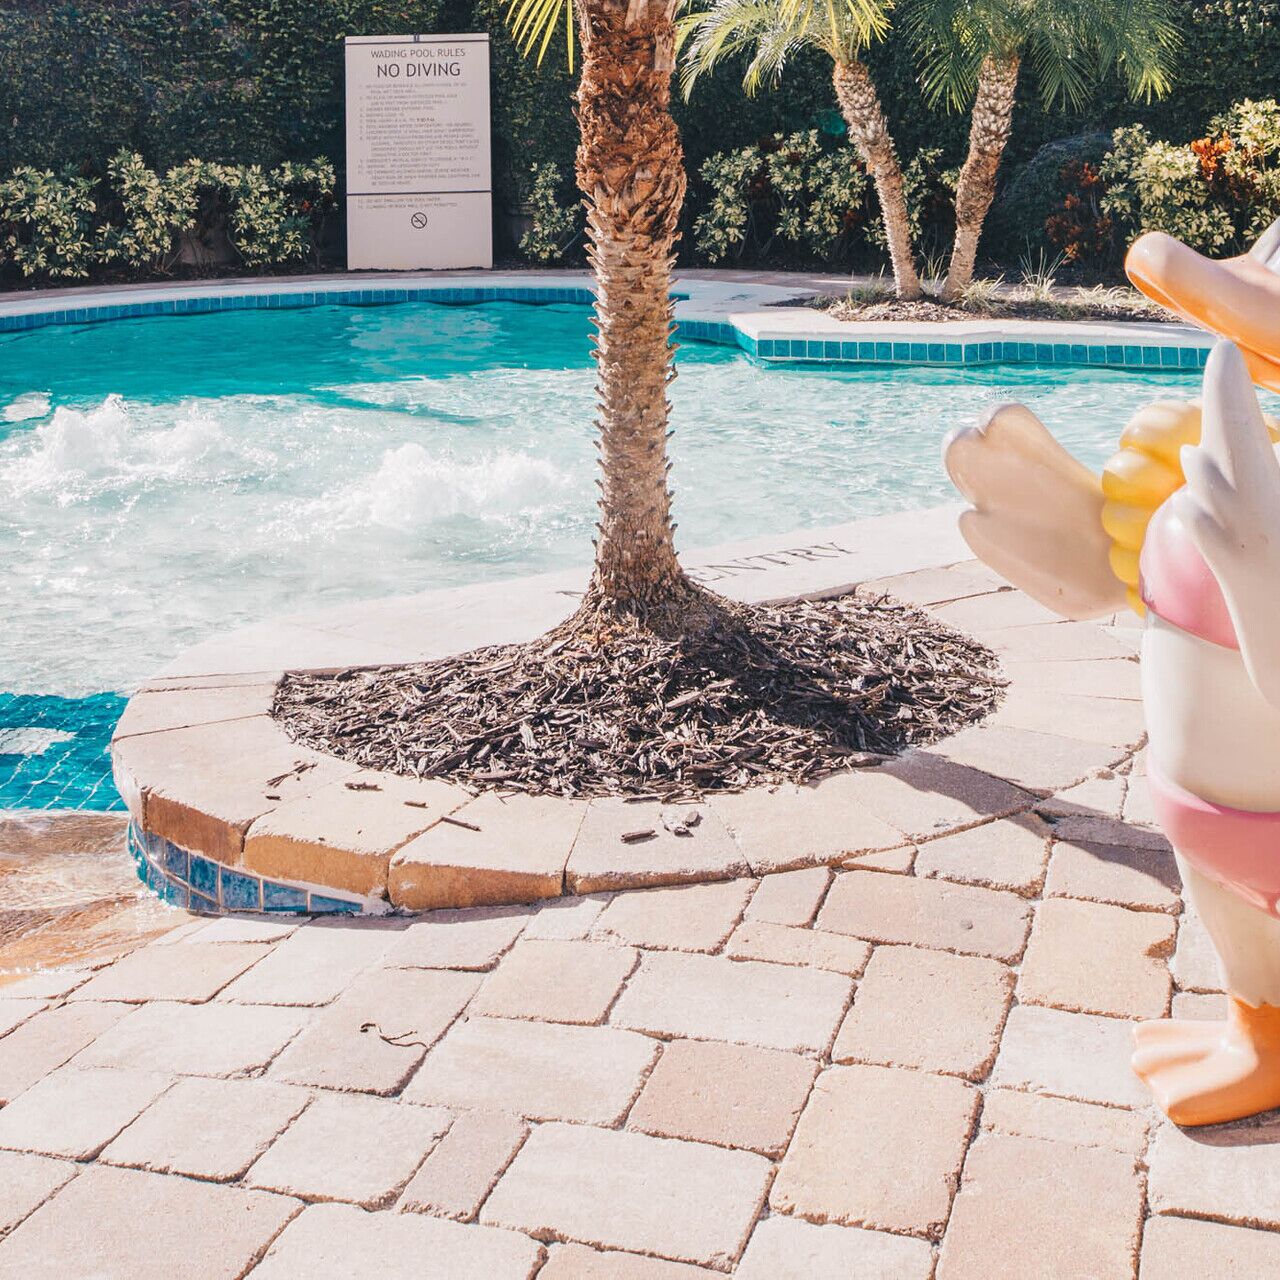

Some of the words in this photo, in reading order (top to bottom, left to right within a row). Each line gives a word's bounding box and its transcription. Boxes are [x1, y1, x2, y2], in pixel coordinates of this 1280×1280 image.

[371, 50, 407, 58] WADING
[410, 49, 435, 58] POOL
[438, 48, 466, 57] RULES
[377, 63, 400, 78] NO
[406, 62, 461, 77] DIVING
[683, 541, 860, 583] ENTRY
